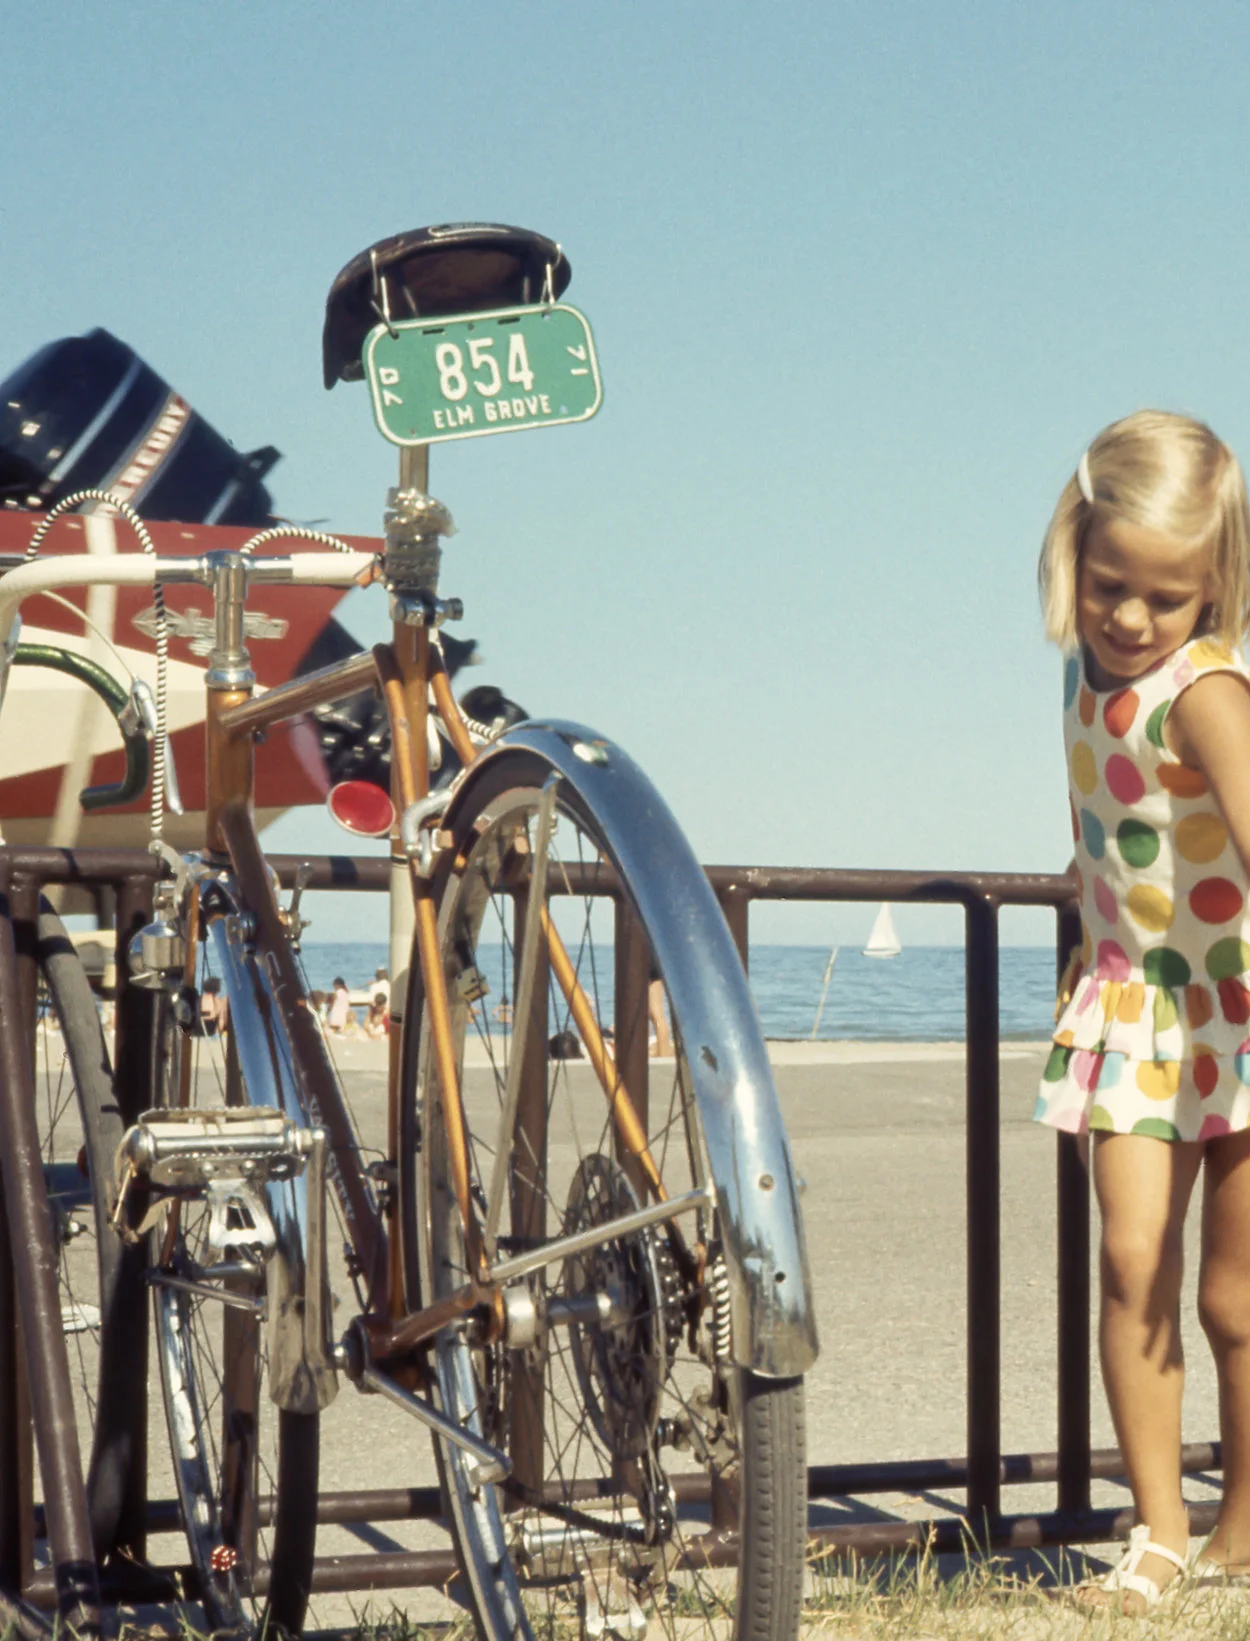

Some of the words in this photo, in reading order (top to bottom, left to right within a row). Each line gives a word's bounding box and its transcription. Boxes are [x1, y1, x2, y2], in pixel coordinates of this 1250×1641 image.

[435, 333, 534, 401] 854
[566, 344, 589, 376] 71
[379, 367, 403, 406] 70
[432, 404, 475, 429] ELM
[483, 394, 552, 422] GROVE
